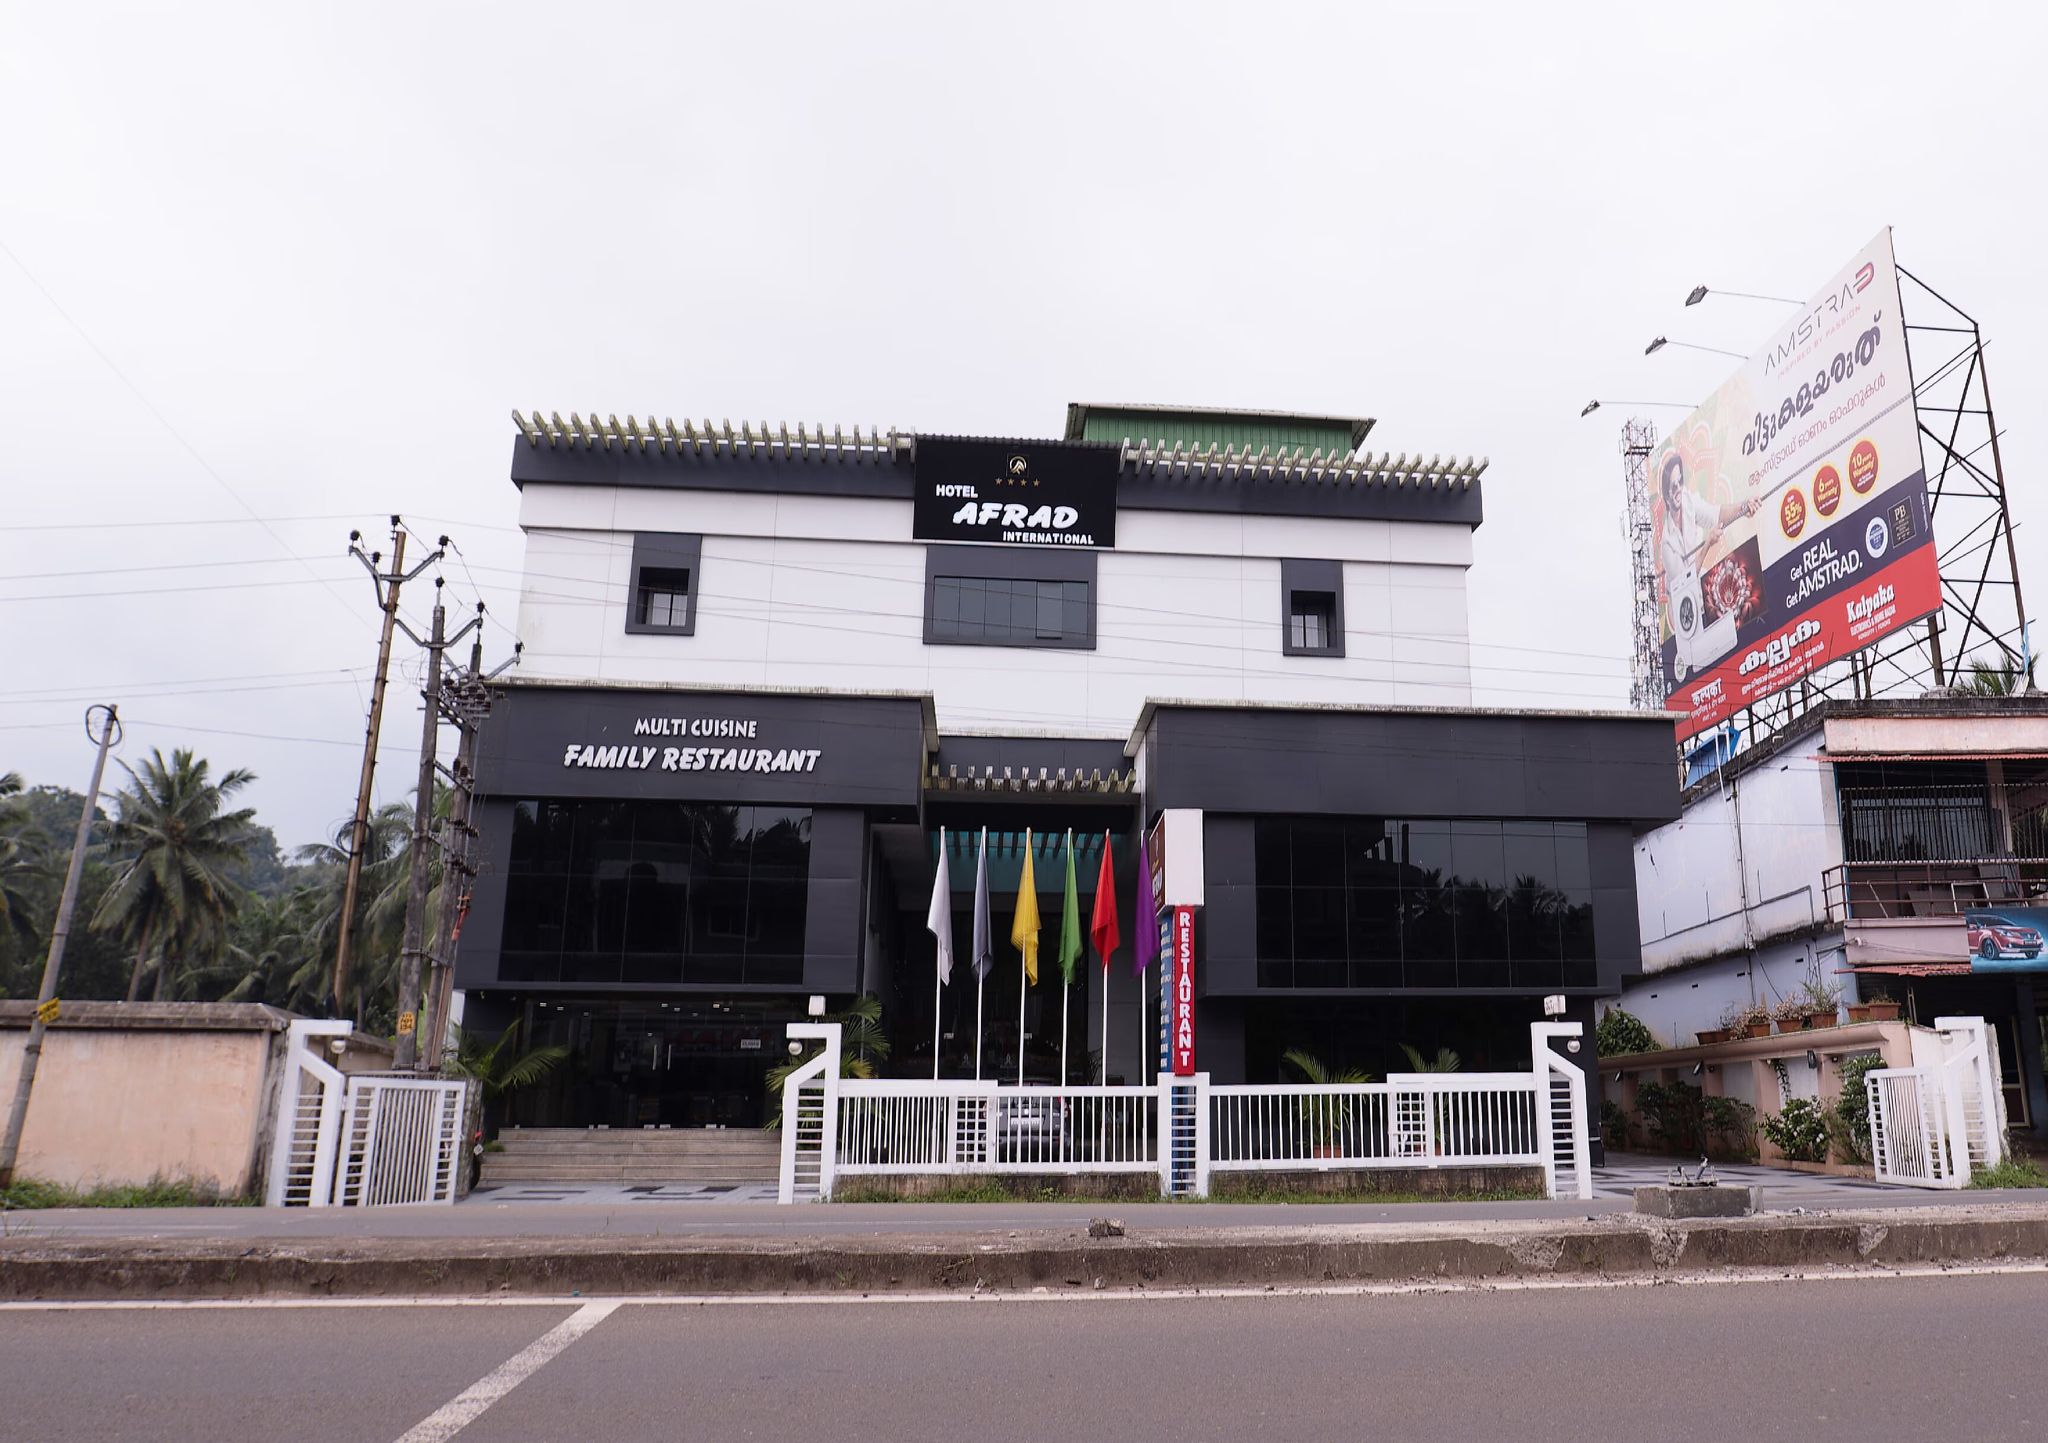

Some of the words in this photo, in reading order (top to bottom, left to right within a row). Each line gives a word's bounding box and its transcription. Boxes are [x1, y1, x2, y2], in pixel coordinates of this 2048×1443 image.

[1765, 261, 1875, 376] AMSTRAD
[1852, 453, 1862, 468] 10
[935, 483, 979, 499] HOTEL
[1818, 478, 1825, 493] 6
[953, 501, 1079, 530] AFRAD
[1784, 501, 1803, 521] 55%
[1894, 504, 1906, 521] PB
[1003, 530, 1095, 545] INTERNATIONAL
[1790, 565, 1803, 582] Get
[1802, 538, 1838, 573] REAL.
[1785, 592, 1798, 609] Get
[1798, 549, 1863, 602] AMSTRAD.
[1846, 584, 1895, 624] Kalpaka
[634, 717, 687, 737] MULTI
[690, 718, 757, 738] CUISINE
[564, 744, 657, 769] FAMILY
[661, 747, 821, 773] RESTAURANT
[1179, 911, 1192, 1067] RESTAURANT
